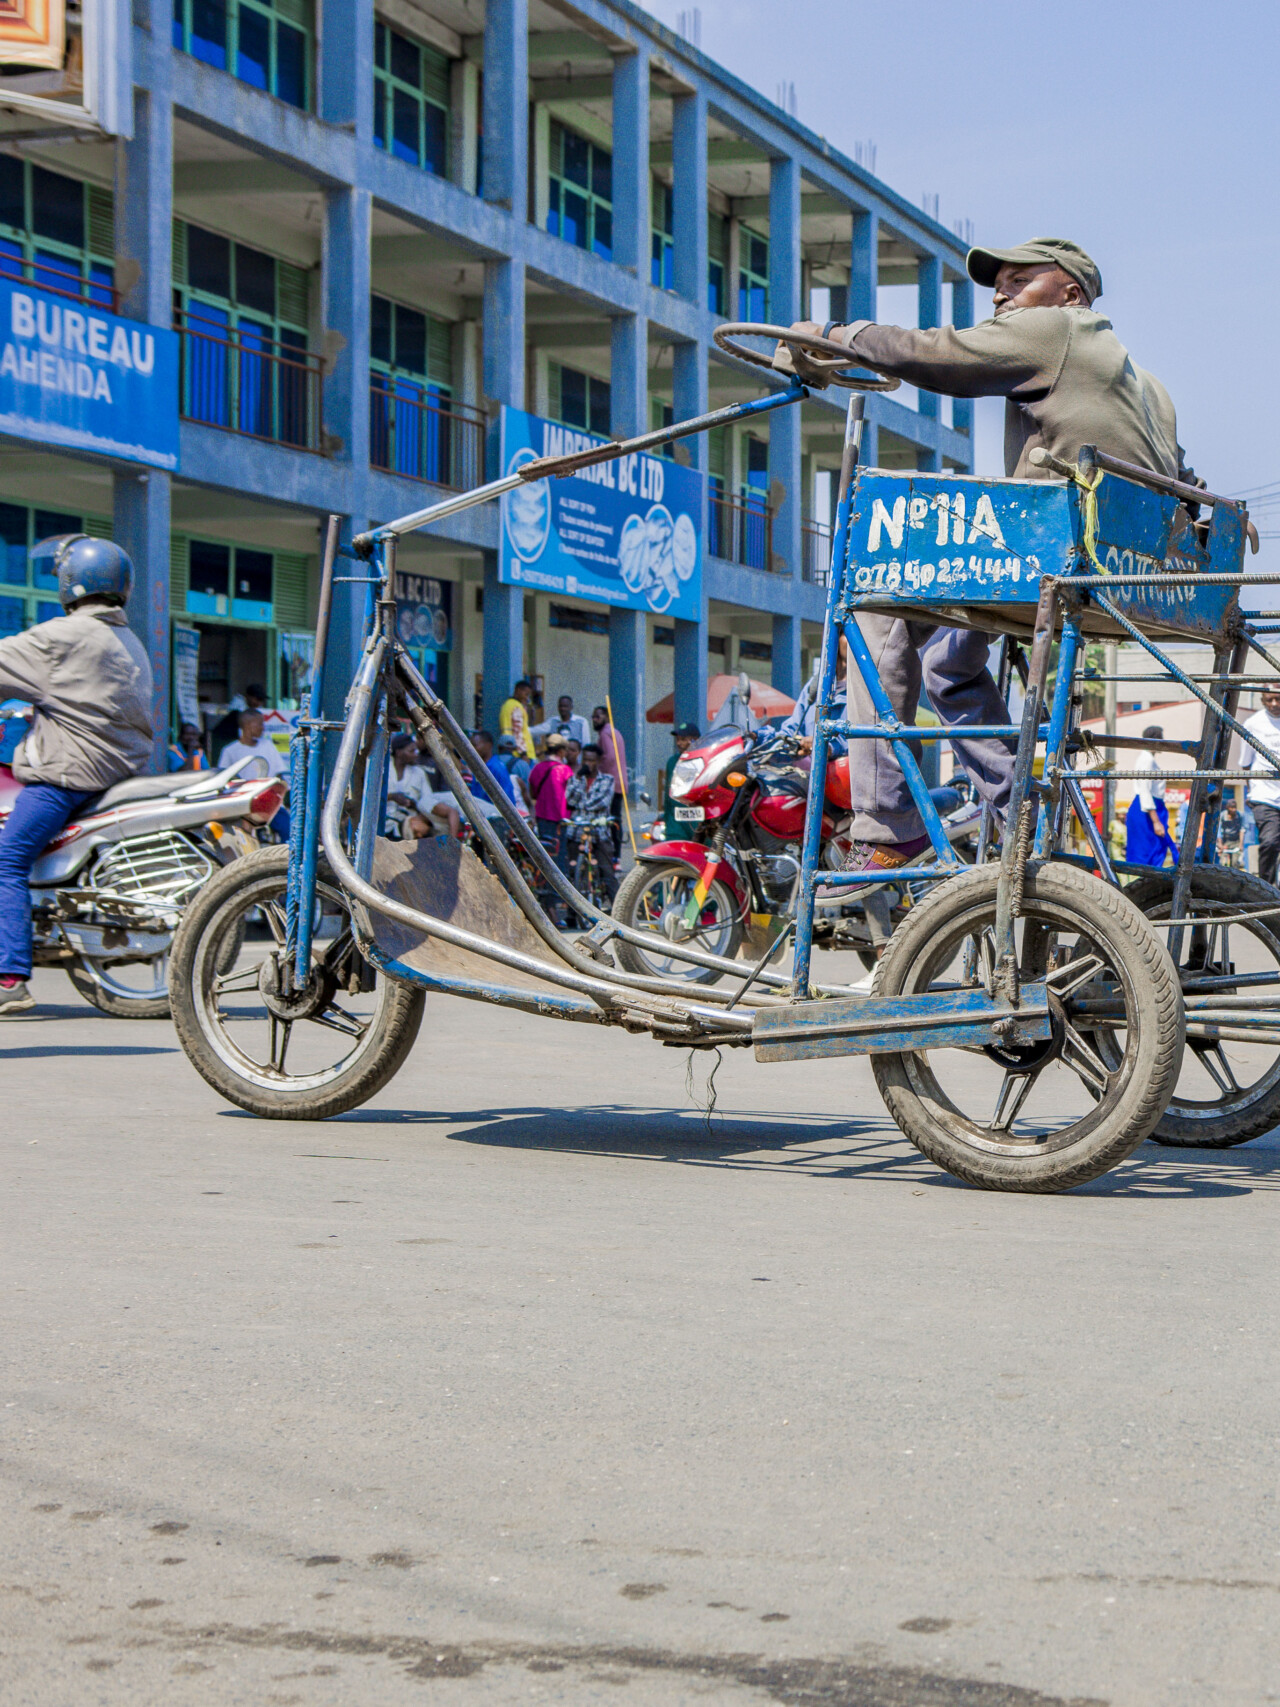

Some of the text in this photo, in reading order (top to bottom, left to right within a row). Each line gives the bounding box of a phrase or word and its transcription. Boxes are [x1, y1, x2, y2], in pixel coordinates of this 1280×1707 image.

[11, 291, 155, 374] BUREAU
[618, 450, 638, 497] BC
[640, 456, 665, 503] LTD
